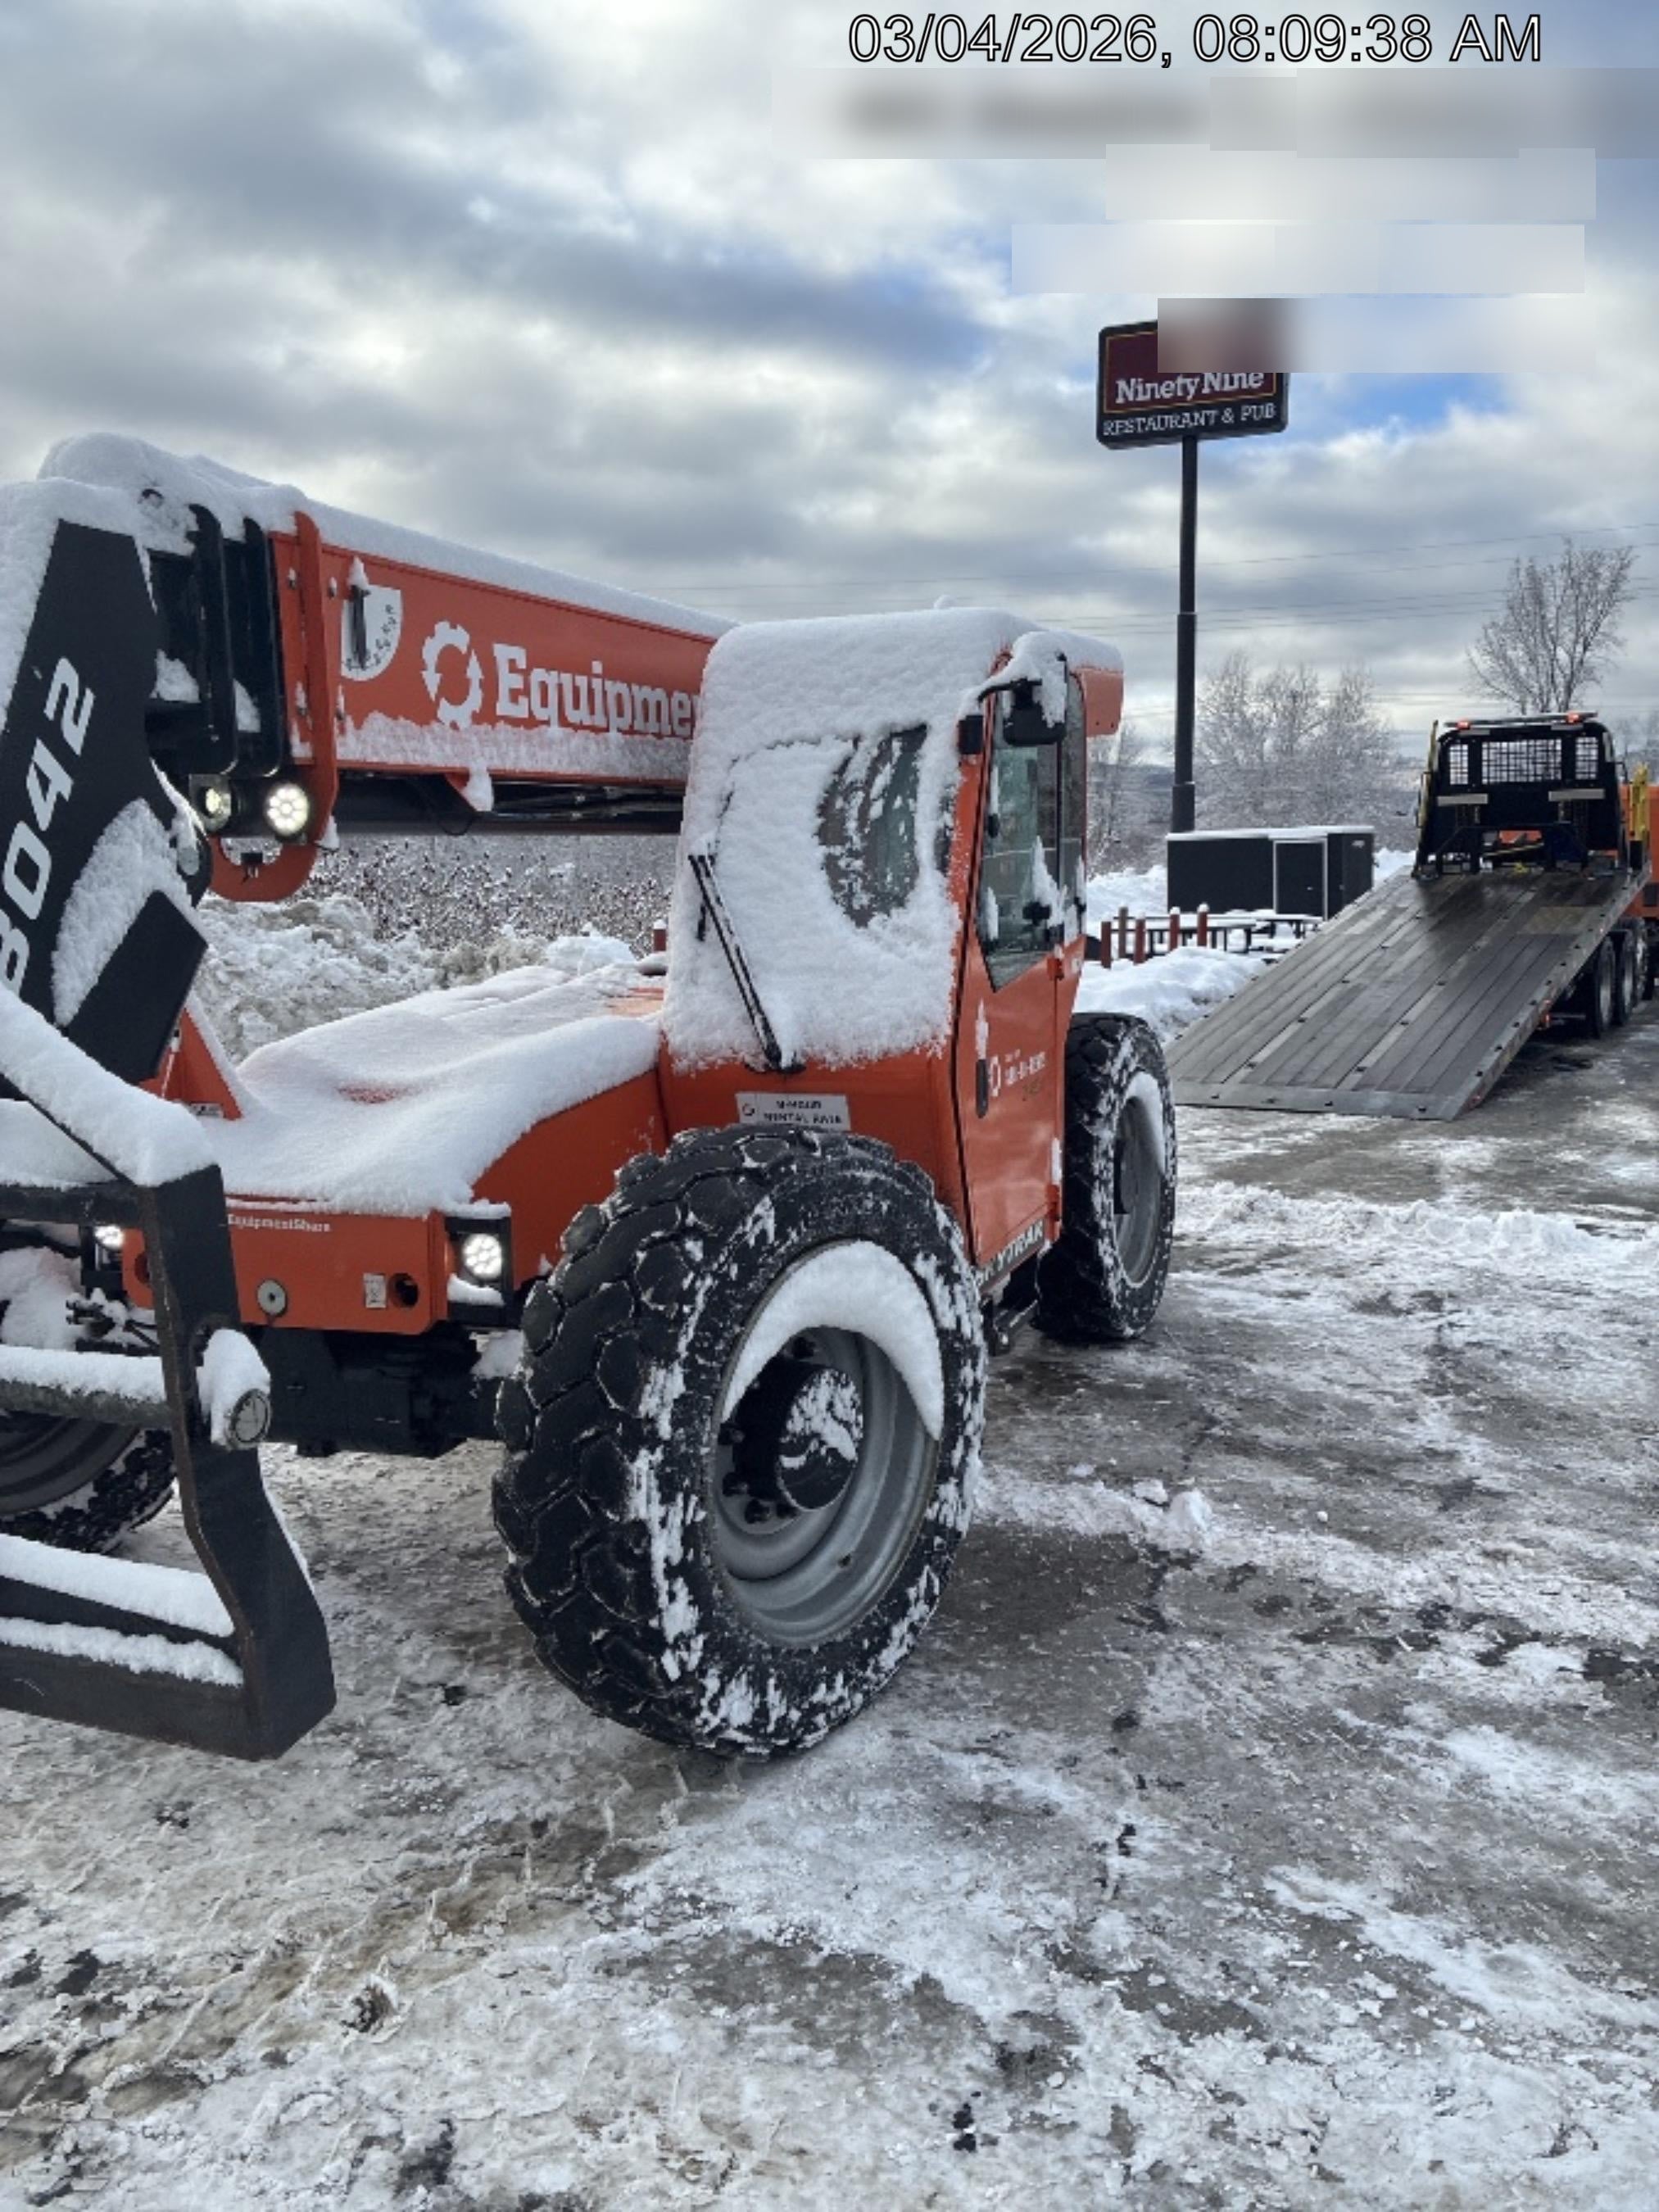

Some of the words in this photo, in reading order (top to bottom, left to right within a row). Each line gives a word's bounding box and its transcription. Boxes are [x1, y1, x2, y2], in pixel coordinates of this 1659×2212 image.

[1114, 374, 1199, 404] Ninety
[1103, 410, 1219, 436] RESTAURANT
[1221, 407, 1234, 424] &
[1240, 402, 1276, 422] PUB
[0, 656, 95, 997] 8042
